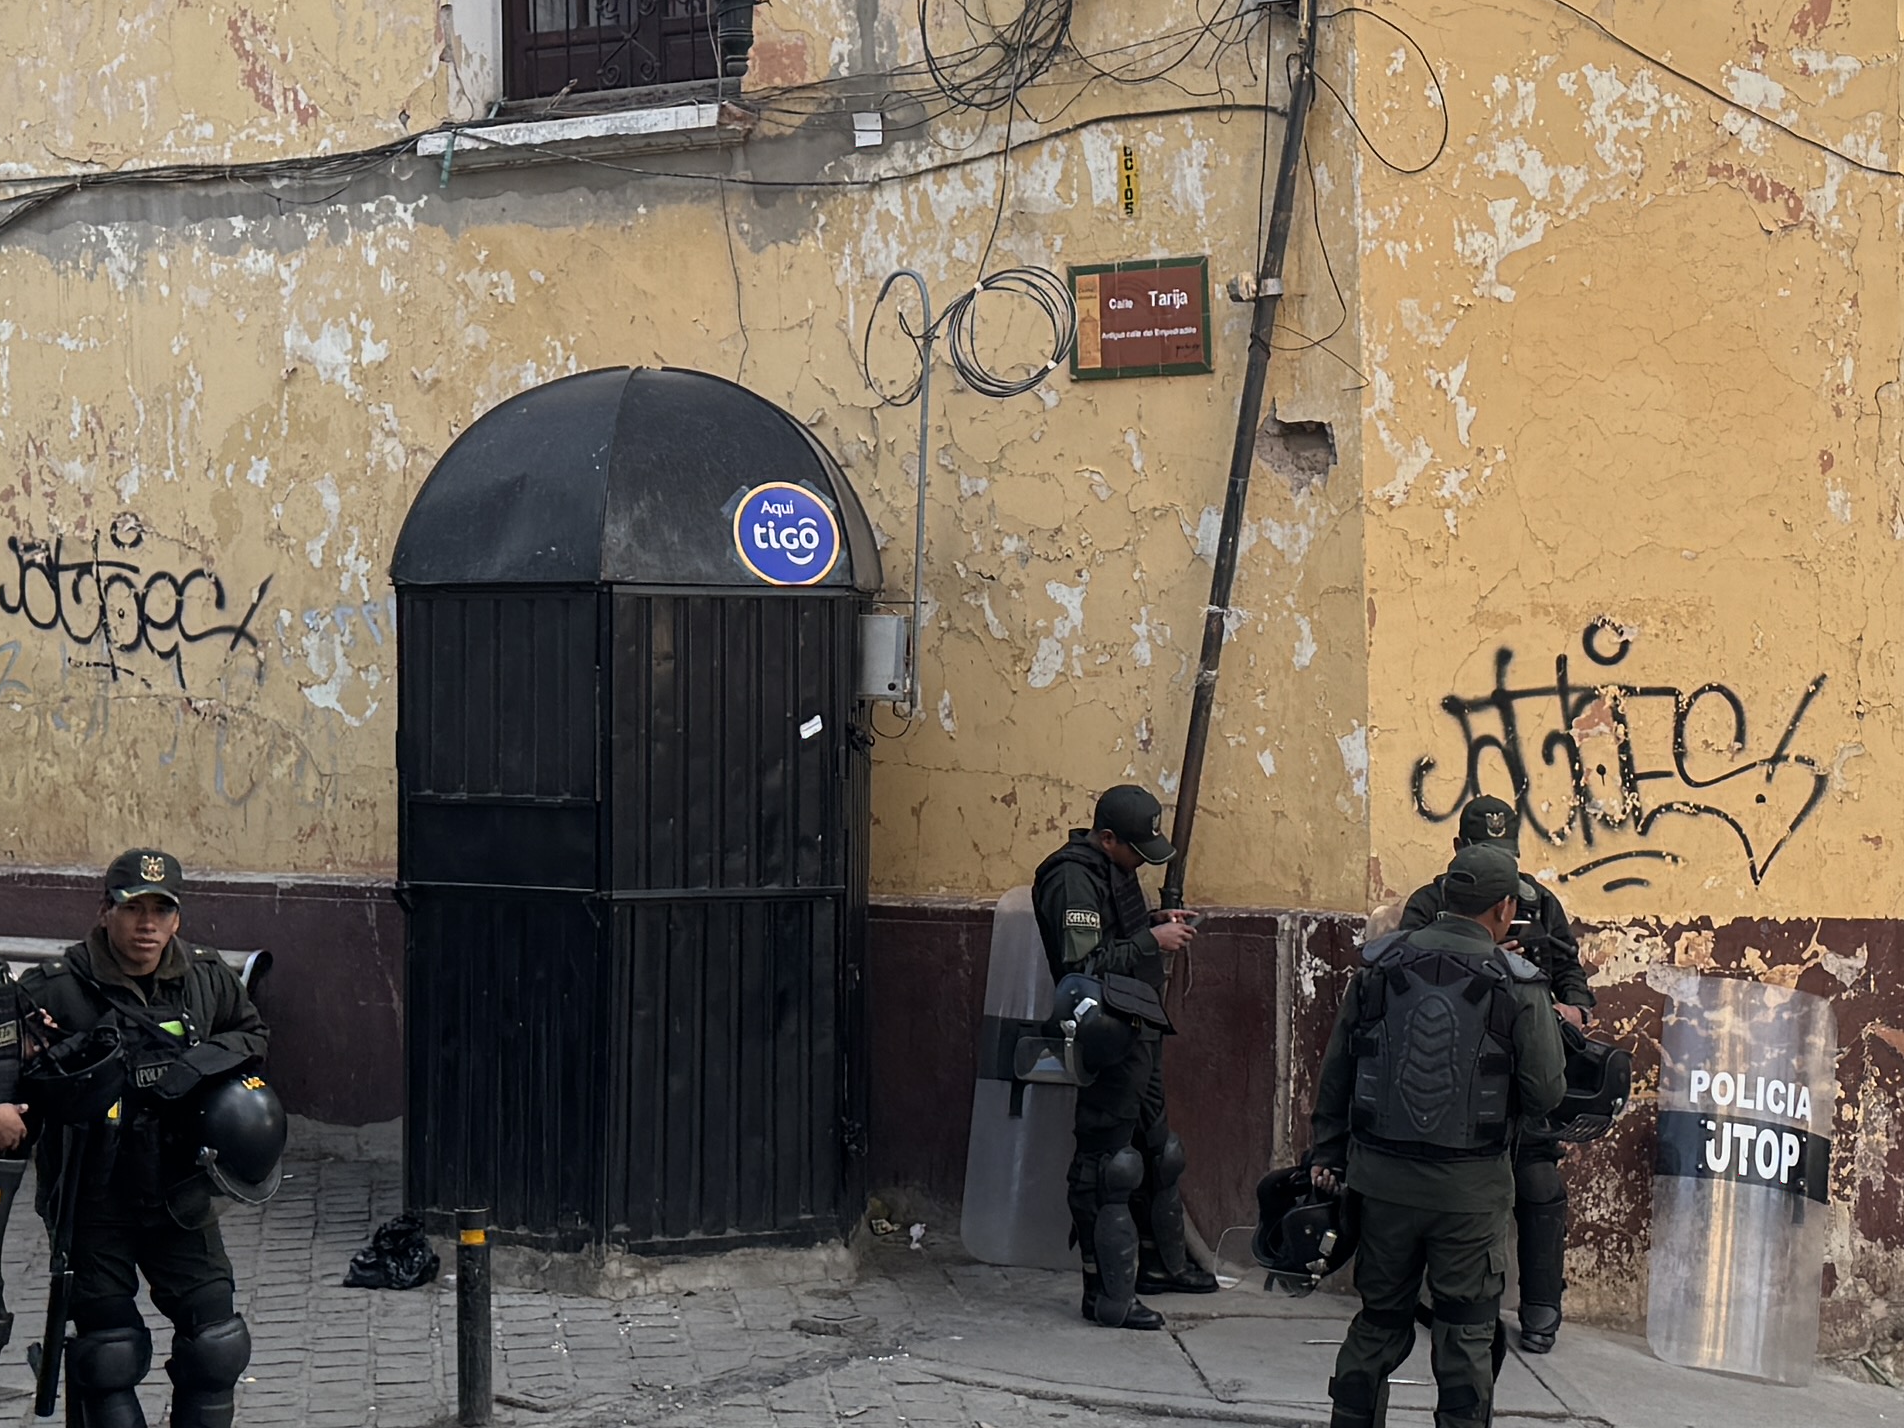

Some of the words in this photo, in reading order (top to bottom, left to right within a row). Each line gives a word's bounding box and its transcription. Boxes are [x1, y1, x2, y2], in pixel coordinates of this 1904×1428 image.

[1148, 289, 1189, 310] Tarija
[753, 518, 820, 550] tigo
[1689, 1069, 1812, 1123] POLICIA
[1705, 1120, 1800, 1185] UTOP
